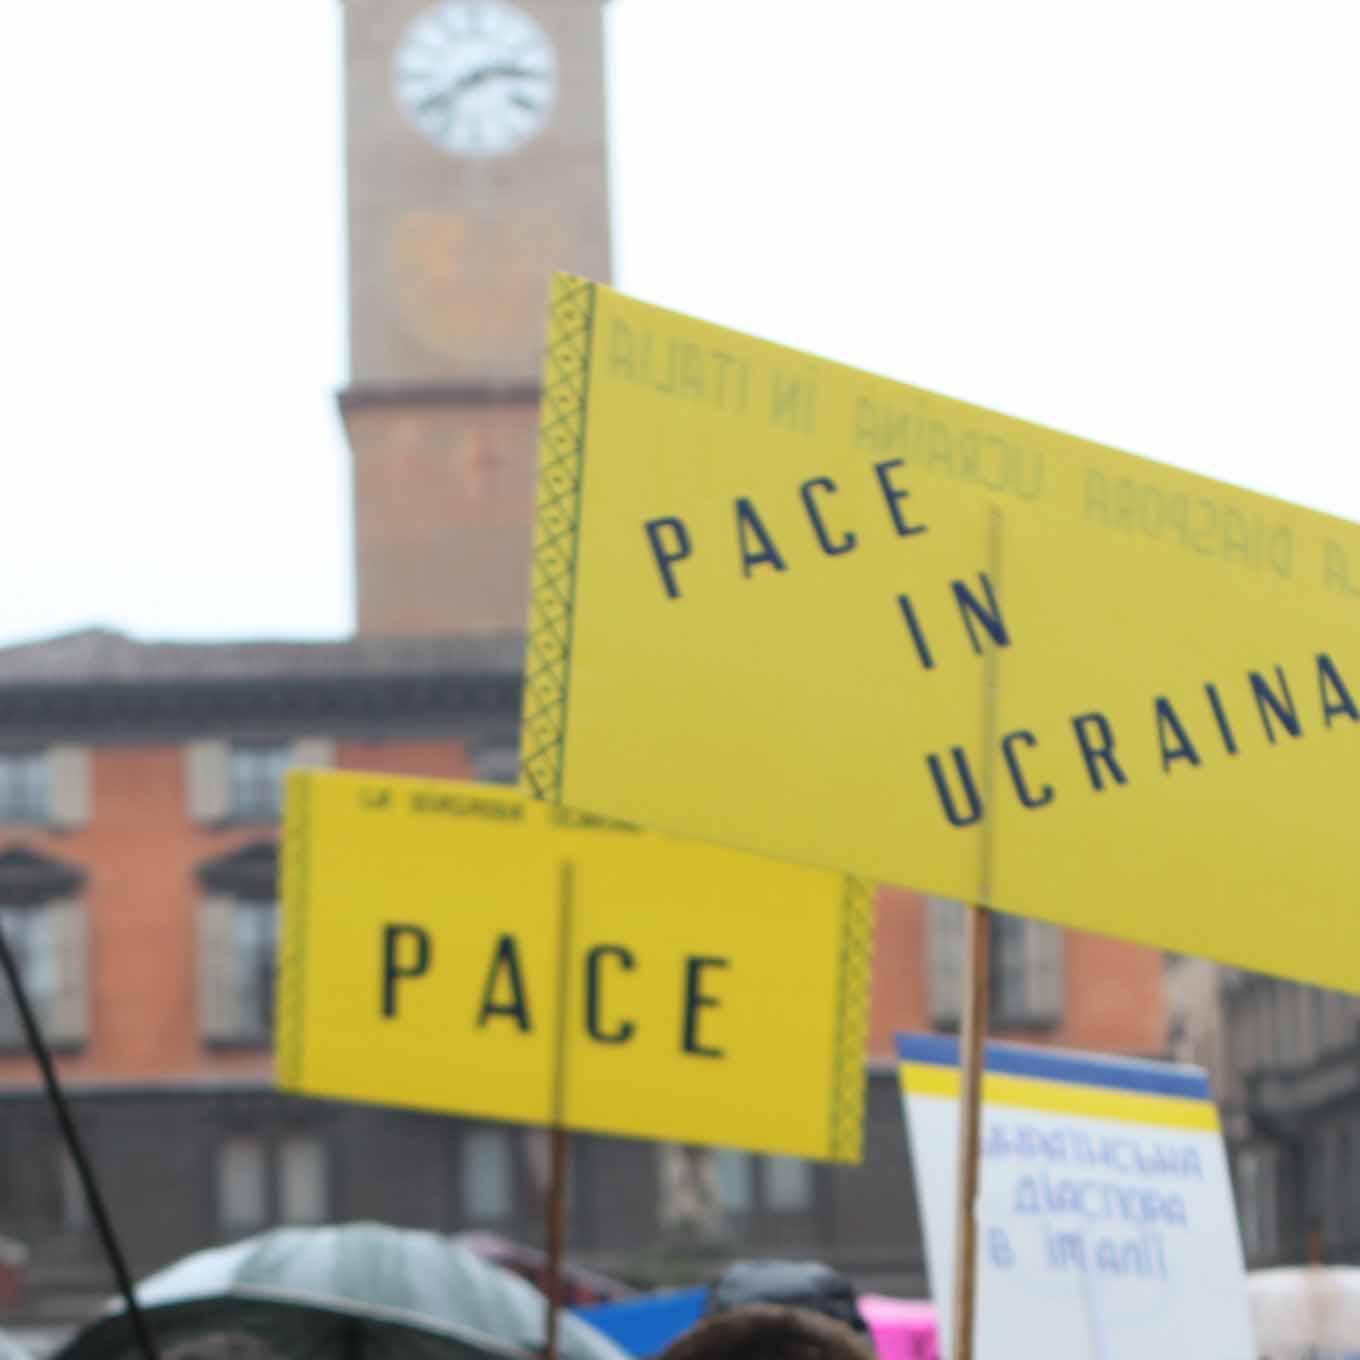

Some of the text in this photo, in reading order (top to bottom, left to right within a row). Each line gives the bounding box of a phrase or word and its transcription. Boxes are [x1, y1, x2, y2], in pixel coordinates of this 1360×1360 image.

[644, 458, 928, 600] PACE
[896, 571, 1011, 670] IN
[381, 922, 729, 1060] PACE
